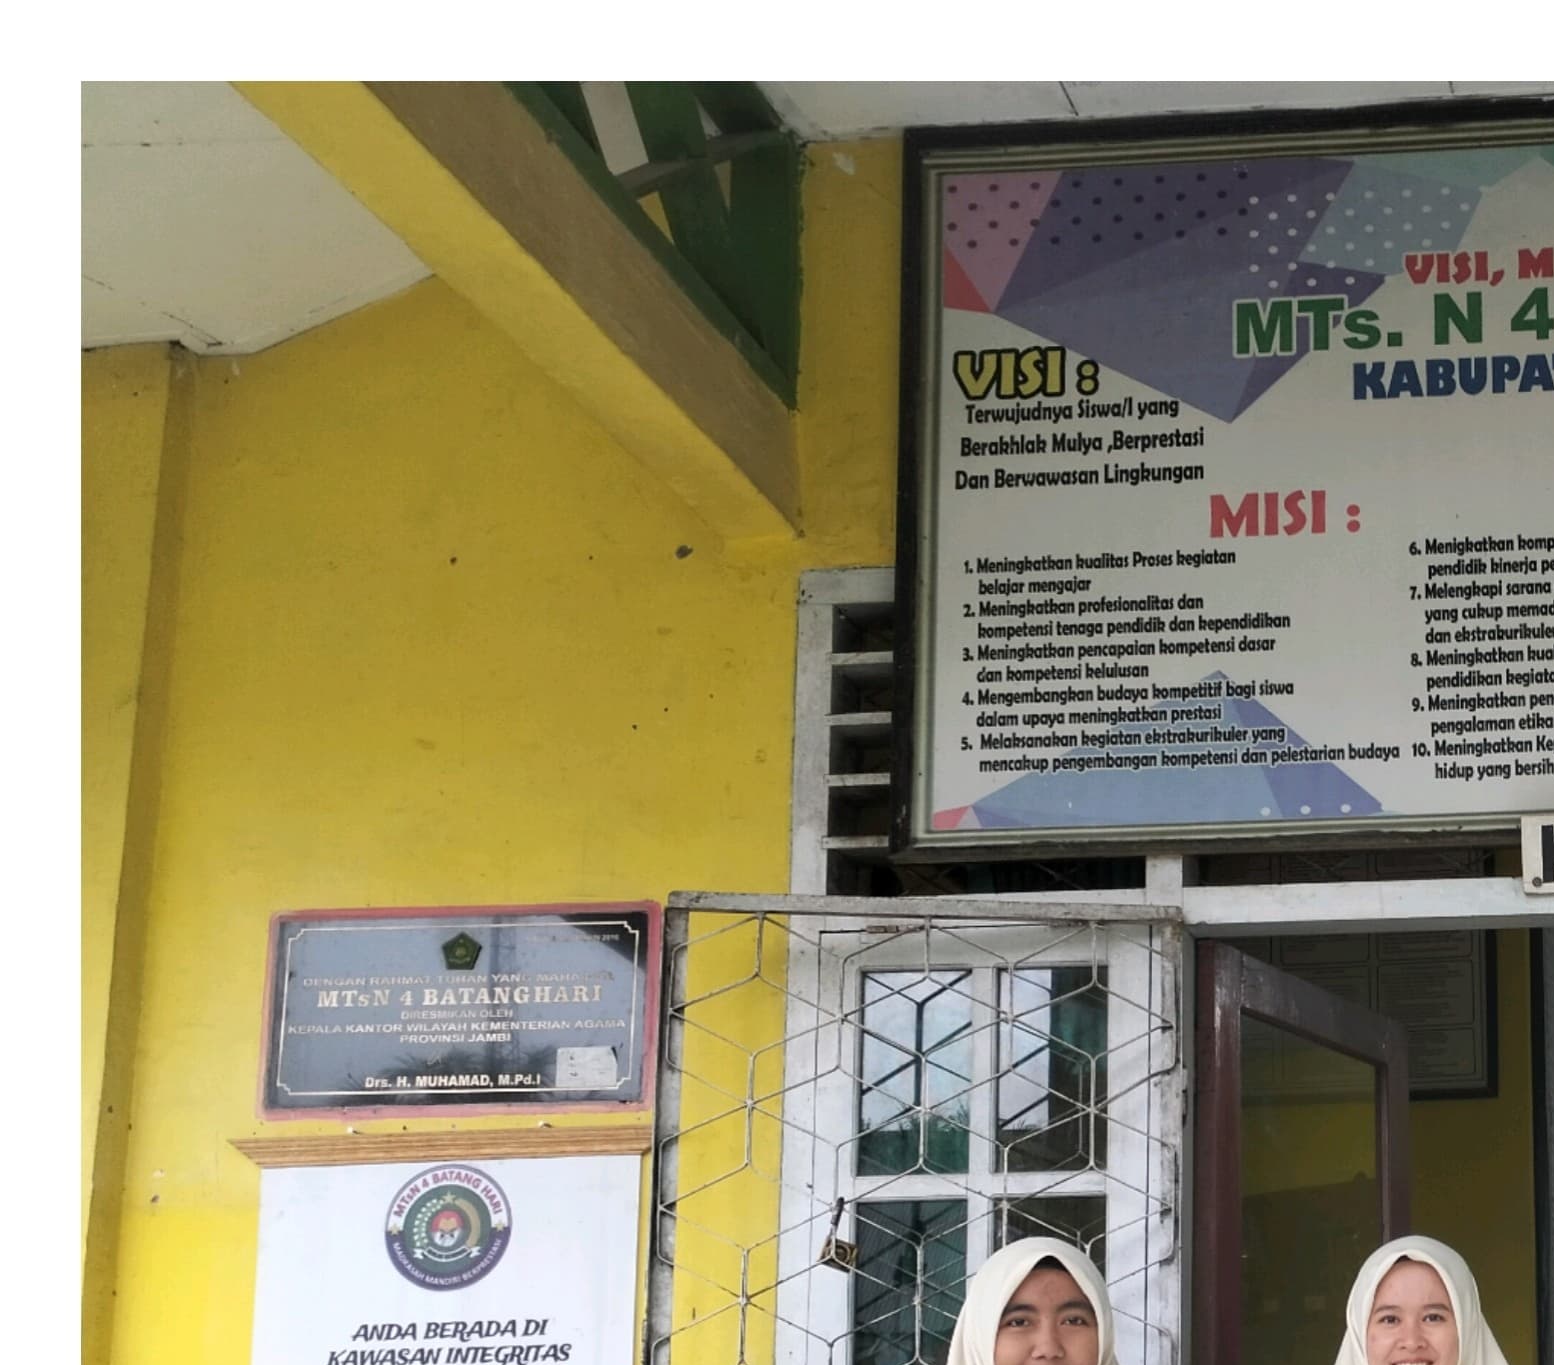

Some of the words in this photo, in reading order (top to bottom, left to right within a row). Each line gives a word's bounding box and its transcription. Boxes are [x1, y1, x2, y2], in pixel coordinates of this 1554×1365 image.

[1405, 251, 1504, 286] VISI,
[1236, 297, 1403, 355] MTs.
[1434, 291, 1484, 346] N
[953, 346, 1066, 399] VISI
[964, 400, 1073, 425] Terwujudnya
[1076, 395, 1133, 419] Siswa/I
[1138, 397, 1180, 420] yang
[960, 433, 1047, 457] Berakhlak
[1051, 431, 1103, 456] Mulya
[954, 469, 990, 490] Dan
[993, 467, 1099, 489] Berwawasan
[1103, 461, 1204, 486] Lingkungan
[1209, 490, 1327, 538] MISI
[963, 559, 974, 575] 1.
[975, 554, 1073, 575] Meningkatkan
[1075, 552, 1129, 570] kualitas
[1132, 550, 1174, 568] Proses
[1175, 548, 1236, 568] kegiatan
[977, 577, 1026, 597] belajar
[1027, 575, 1092, 595] mengajar
[978, 753, 1049, 774] mencakup
[1052, 751, 1158, 773] pengembangan
[1160, 747, 1238, 770] kompetensi
[1239, 745, 1268, 765] dan
[1270, 743, 1345, 766] pelestarian
[1347, 742, 1400, 762] budaya
[1411, 741, 1431, 758] 10.
[1434, 736, 1533, 758] Meningkatkan
[1434, 760, 1475, 782] hidup
[1476, 763, 1511, 782] yang
[317, 989, 391, 1008] MTsN
[400, 990, 414, 1006] 4
[422, 985, 603, 1006] BATANGHARI
[288, 1024, 342, 1034] KEPALA
[345, 1023, 402, 1033] KANTOR
[406, 1022, 467, 1032] WILAYAH
[471, 1020, 570, 1031] KEMENTERIAN
[574, 1019, 625, 1029] AGAMA
[400, 1033, 464, 1043] PROVINSI
[468, 1032, 511, 1042] JAMBI
[365, 1076, 392, 1088] Drs.
[396, 1075, 411, 1087] H.
[415, 1074, 494, 1088] MUHAMAD,
[431, 1170, 482, 1189] BATANG
[480, 1184, 503, 1214] HARI
[352, 1322, 417, 1342] ANDA
[424, 1319, 516, 1342] BERADA
[522, 1319, 549, 1337] DI
[446, 1344, 572, 1365] INTEGRITAS
